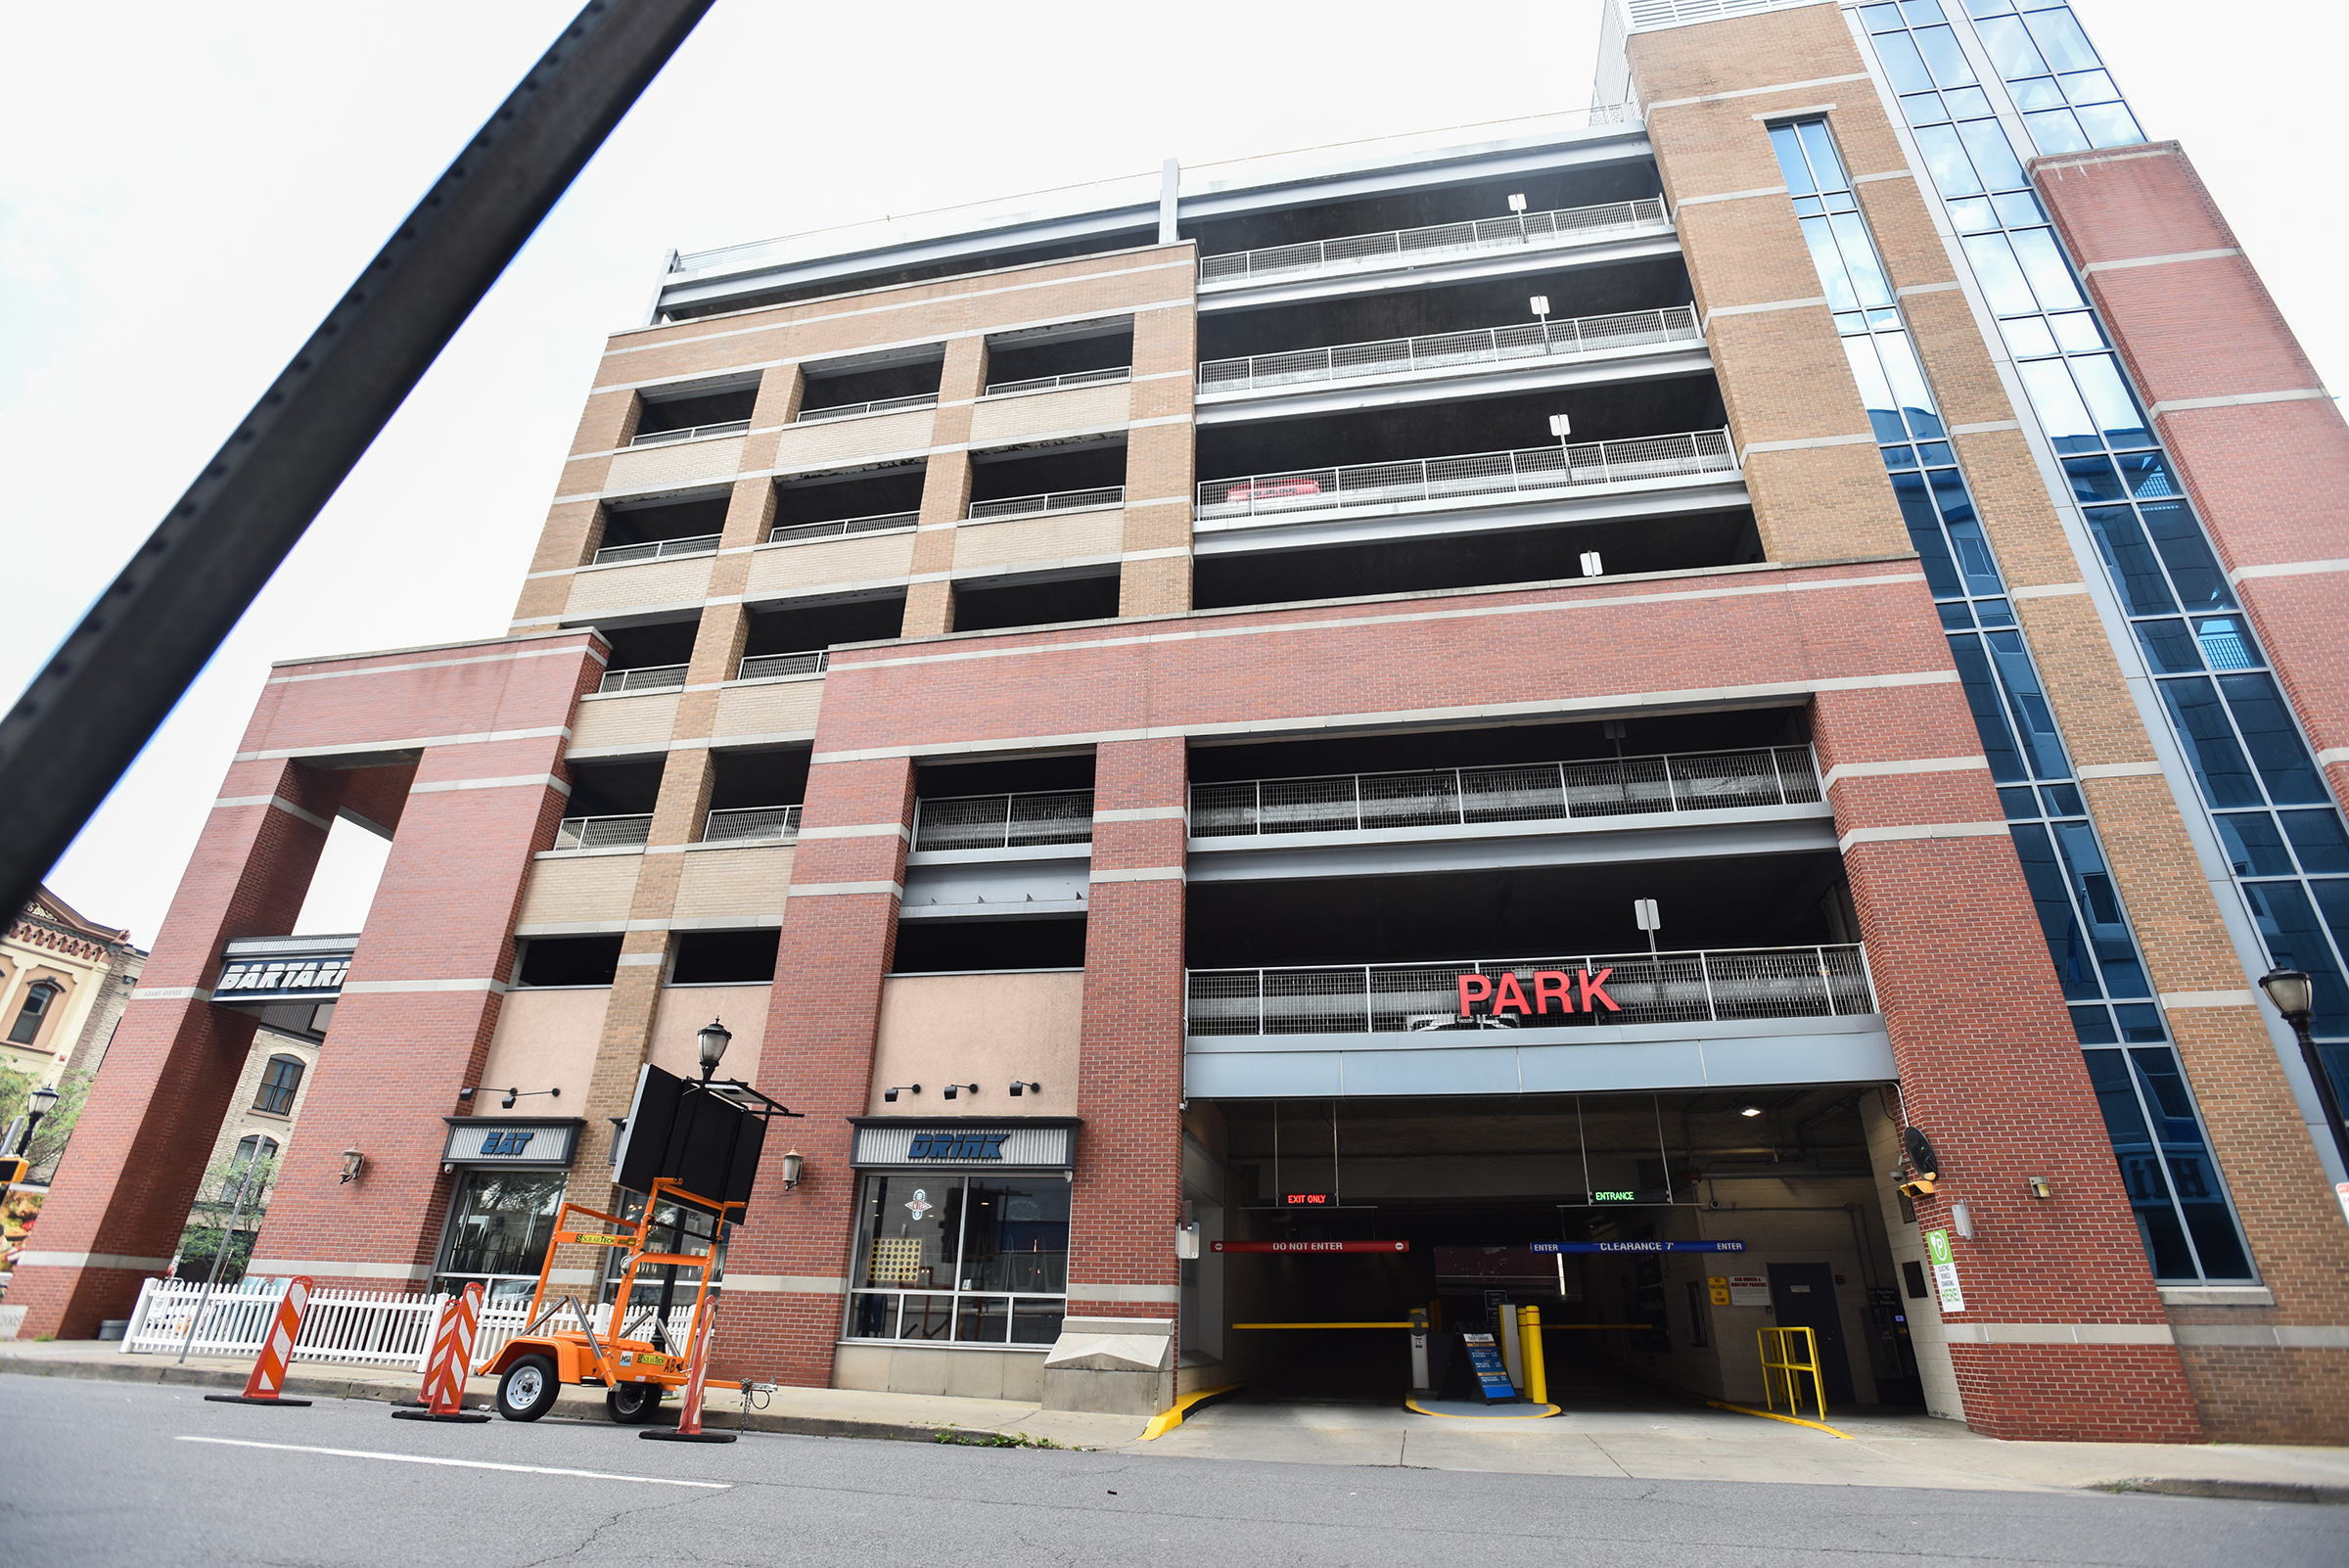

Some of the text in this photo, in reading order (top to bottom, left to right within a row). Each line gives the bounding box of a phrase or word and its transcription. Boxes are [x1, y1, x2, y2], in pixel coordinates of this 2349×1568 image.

[1457, 968, 1622, 1017] PARK
[480, 1132, 534, 1155] EAT
[907, 1133, 1011, 1159] DRINK
[1287, 1194, 1326, 1204] EXIT ONLY
[1595, 1191, 1635, 1201] ENTRANCE
[1272, 1242, 1287, 1251] DO
[1289, 1242, 1309, 1251] NOT
[1600, 1242, 1662, 1251] CLEARANCE
[1717, 1242, 1742, 1251] ENTER
